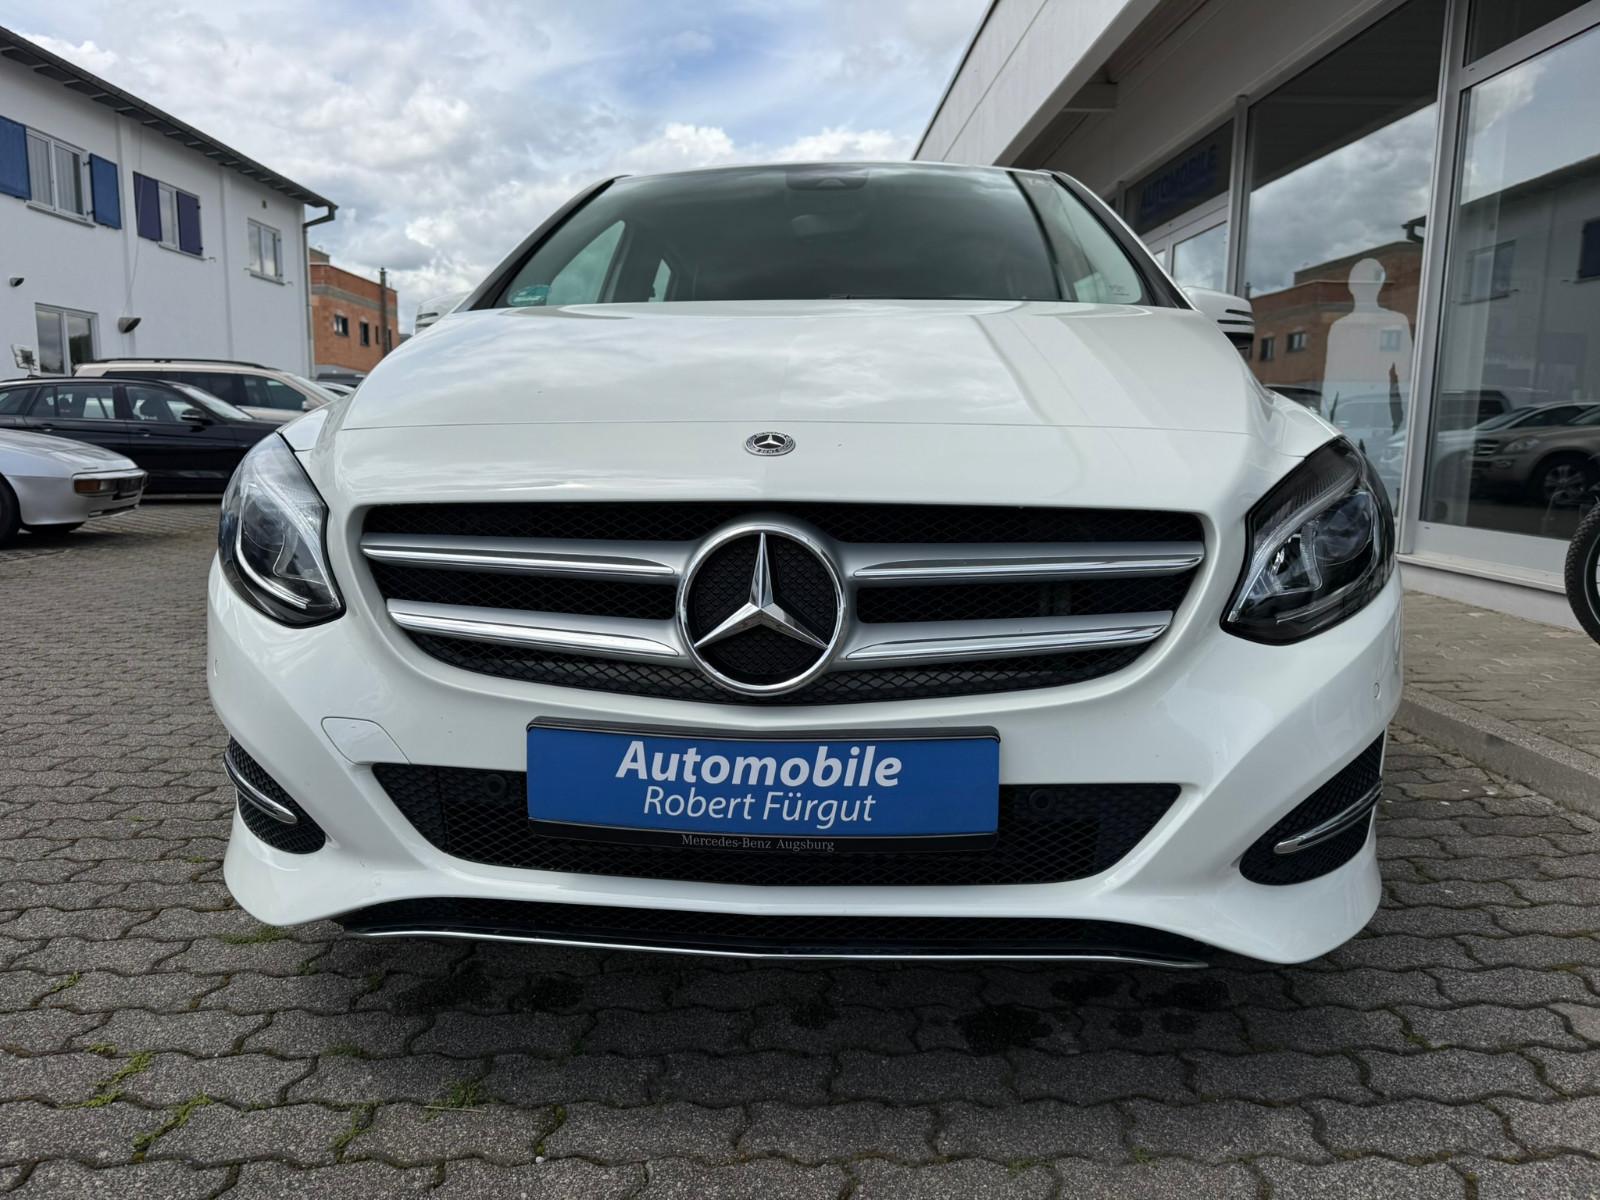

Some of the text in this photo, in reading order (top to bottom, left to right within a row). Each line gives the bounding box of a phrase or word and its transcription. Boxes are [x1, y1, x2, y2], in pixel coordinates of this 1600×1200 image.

[615, 740, 902, 788] Automobile
[643, 785, 876, 830] Robert Fürgut
[681, 834, 835, 852] Mercedes-Benz Augsburg
